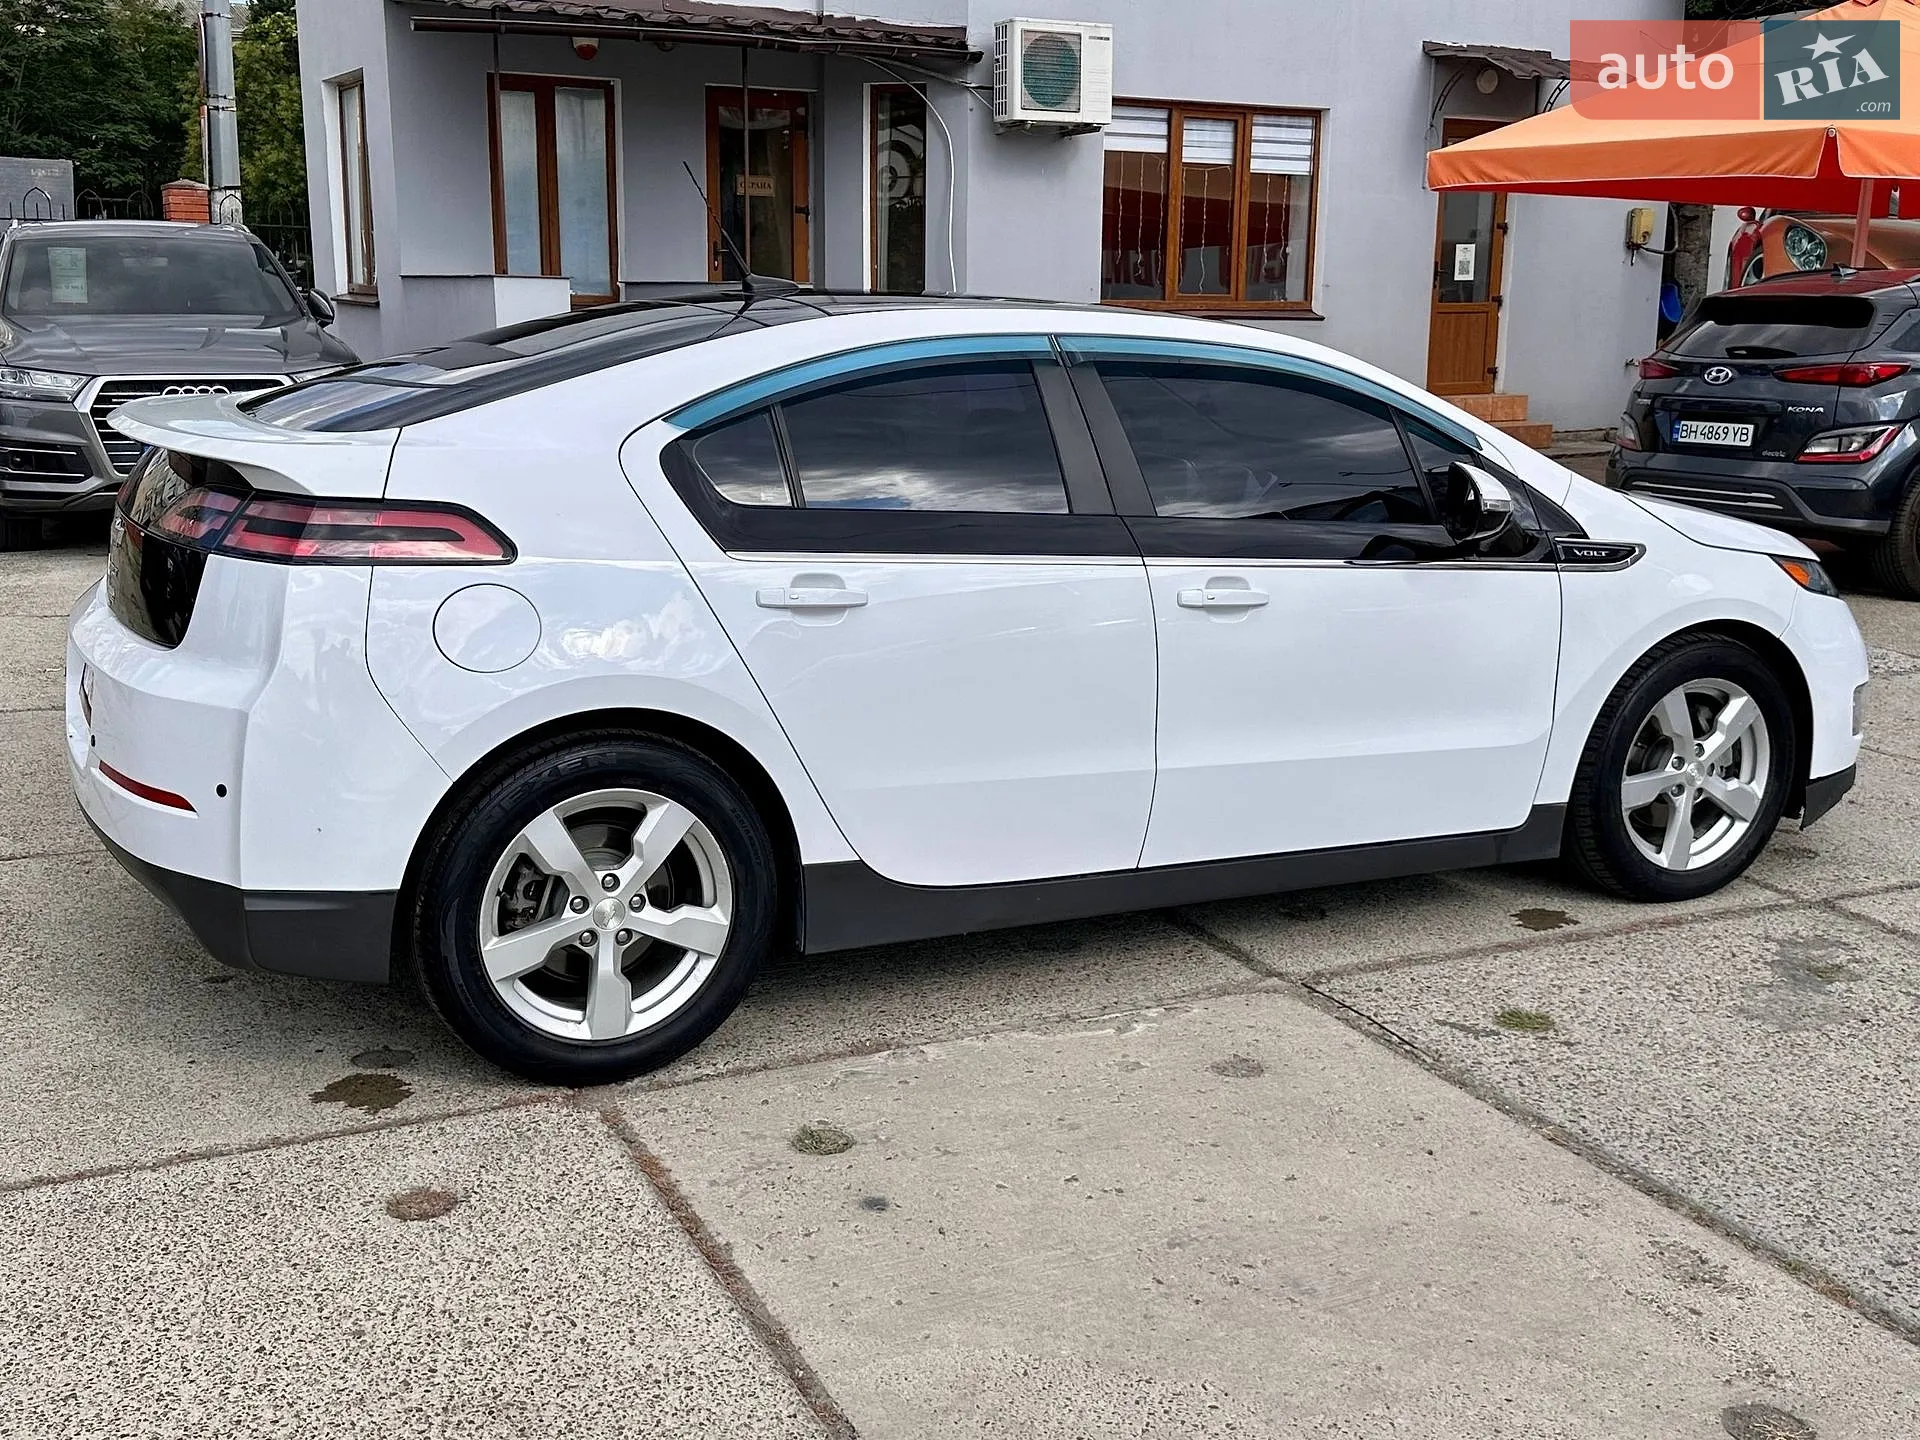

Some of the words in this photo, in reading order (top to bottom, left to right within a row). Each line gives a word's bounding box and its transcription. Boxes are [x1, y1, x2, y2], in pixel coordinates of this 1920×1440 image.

[739, 181, 772, 190] ОРАНА
[1680, 424, 1699, 440] BH
[1700, 425, 1729, 441] 4869
[1732, 426, 1750, 442] YB
[1573, 547, 1609, 557] VOLT
[480, 752, 617, 833] NEXEN
